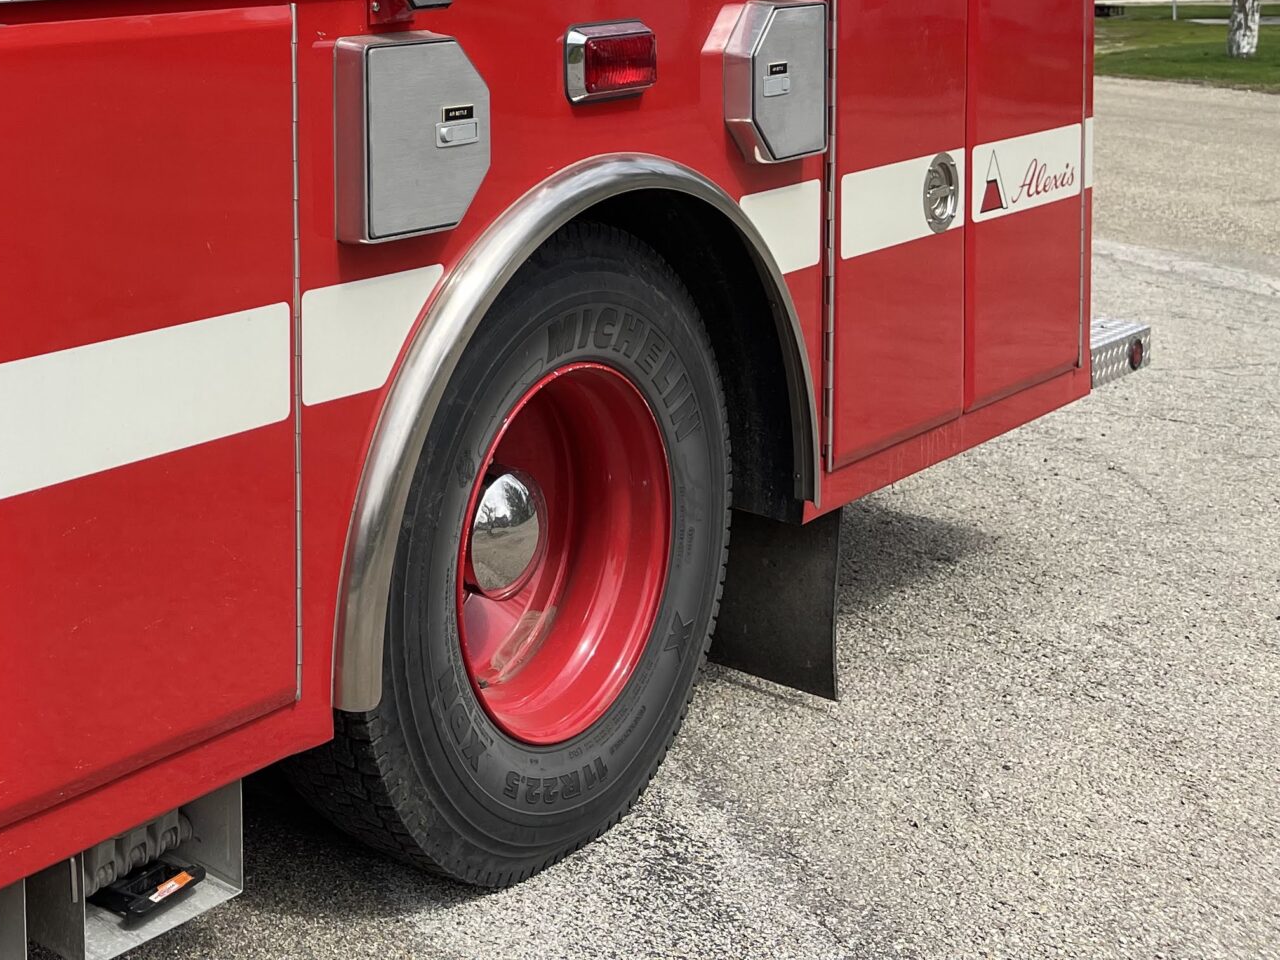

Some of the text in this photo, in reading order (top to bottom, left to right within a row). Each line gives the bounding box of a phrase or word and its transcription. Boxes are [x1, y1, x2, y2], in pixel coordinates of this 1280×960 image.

[1011, 158, 1075, 204] Alexis
[546, 306, 702, 444] MICHELIN
[503, 756, 609, 805] 11R22.5
